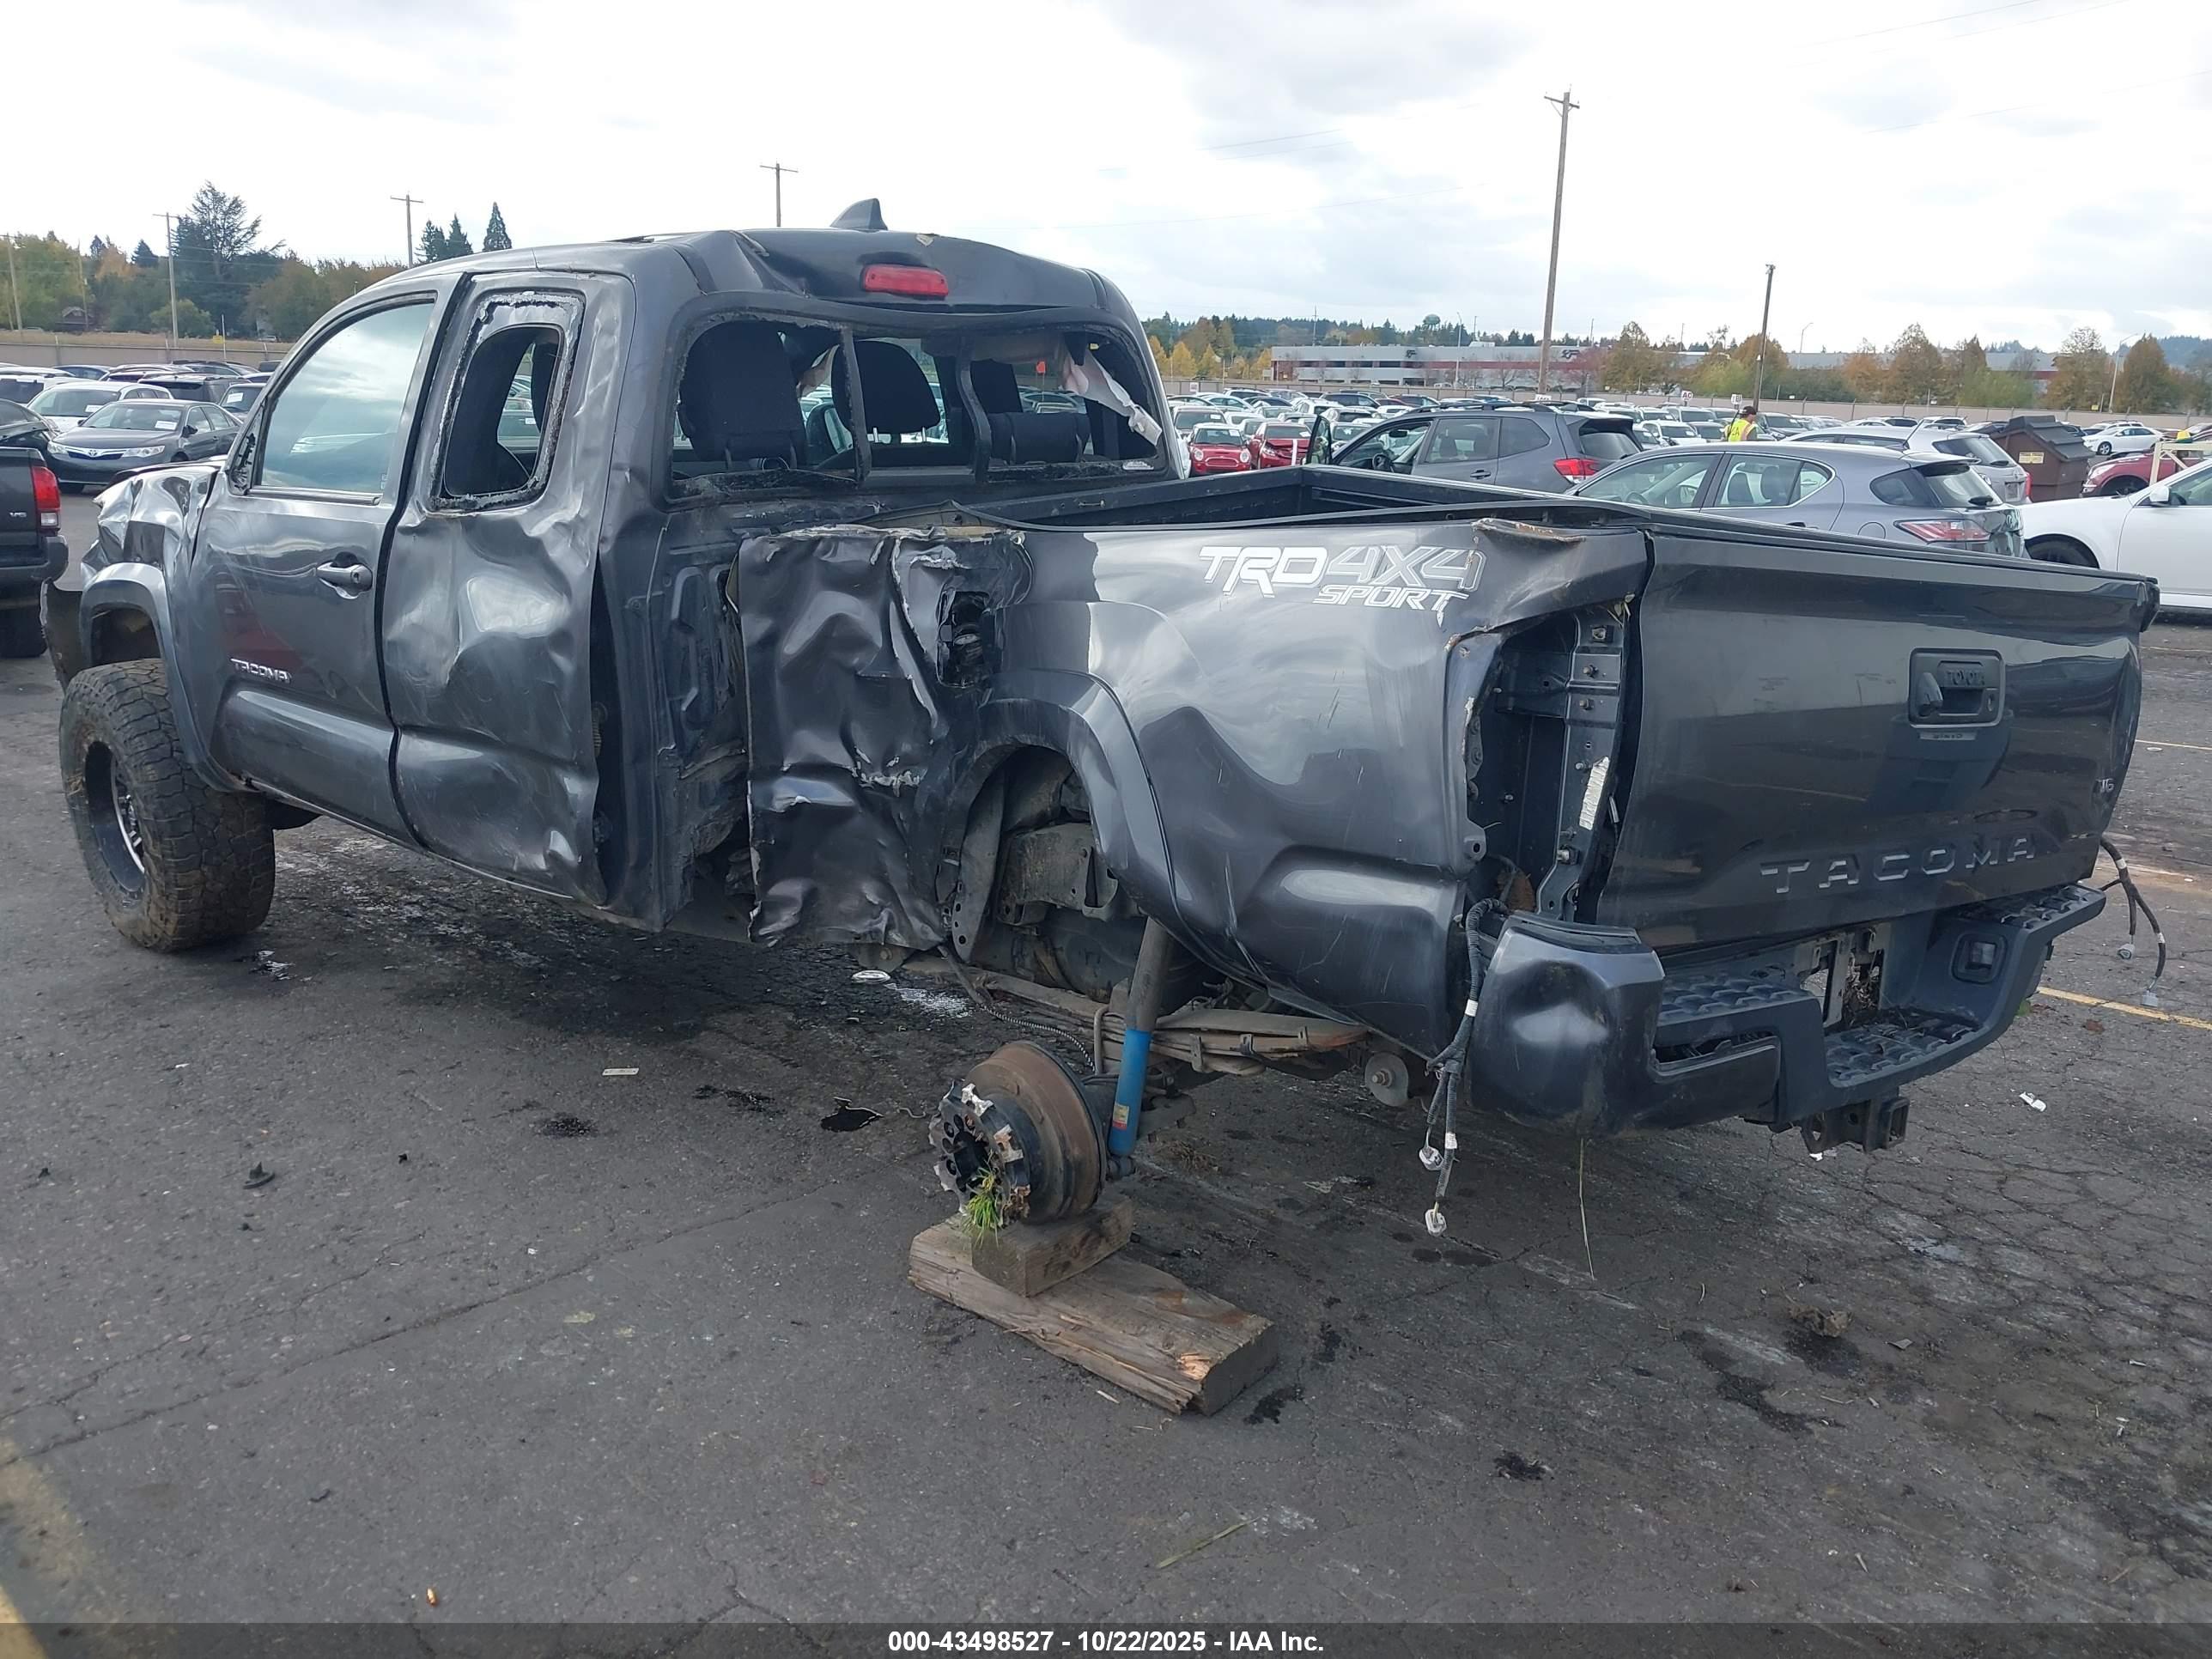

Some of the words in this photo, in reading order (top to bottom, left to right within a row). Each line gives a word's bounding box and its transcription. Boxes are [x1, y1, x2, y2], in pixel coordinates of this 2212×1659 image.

[1200, 545, 1328, 599] TRD
[1326, 544, 1487, 592] 4X4
[1312, 584, 1470, 612] SPORT
[230, 658, 292, 684] TACOMA
[1759, 833, 2036, 894] TACOMA
